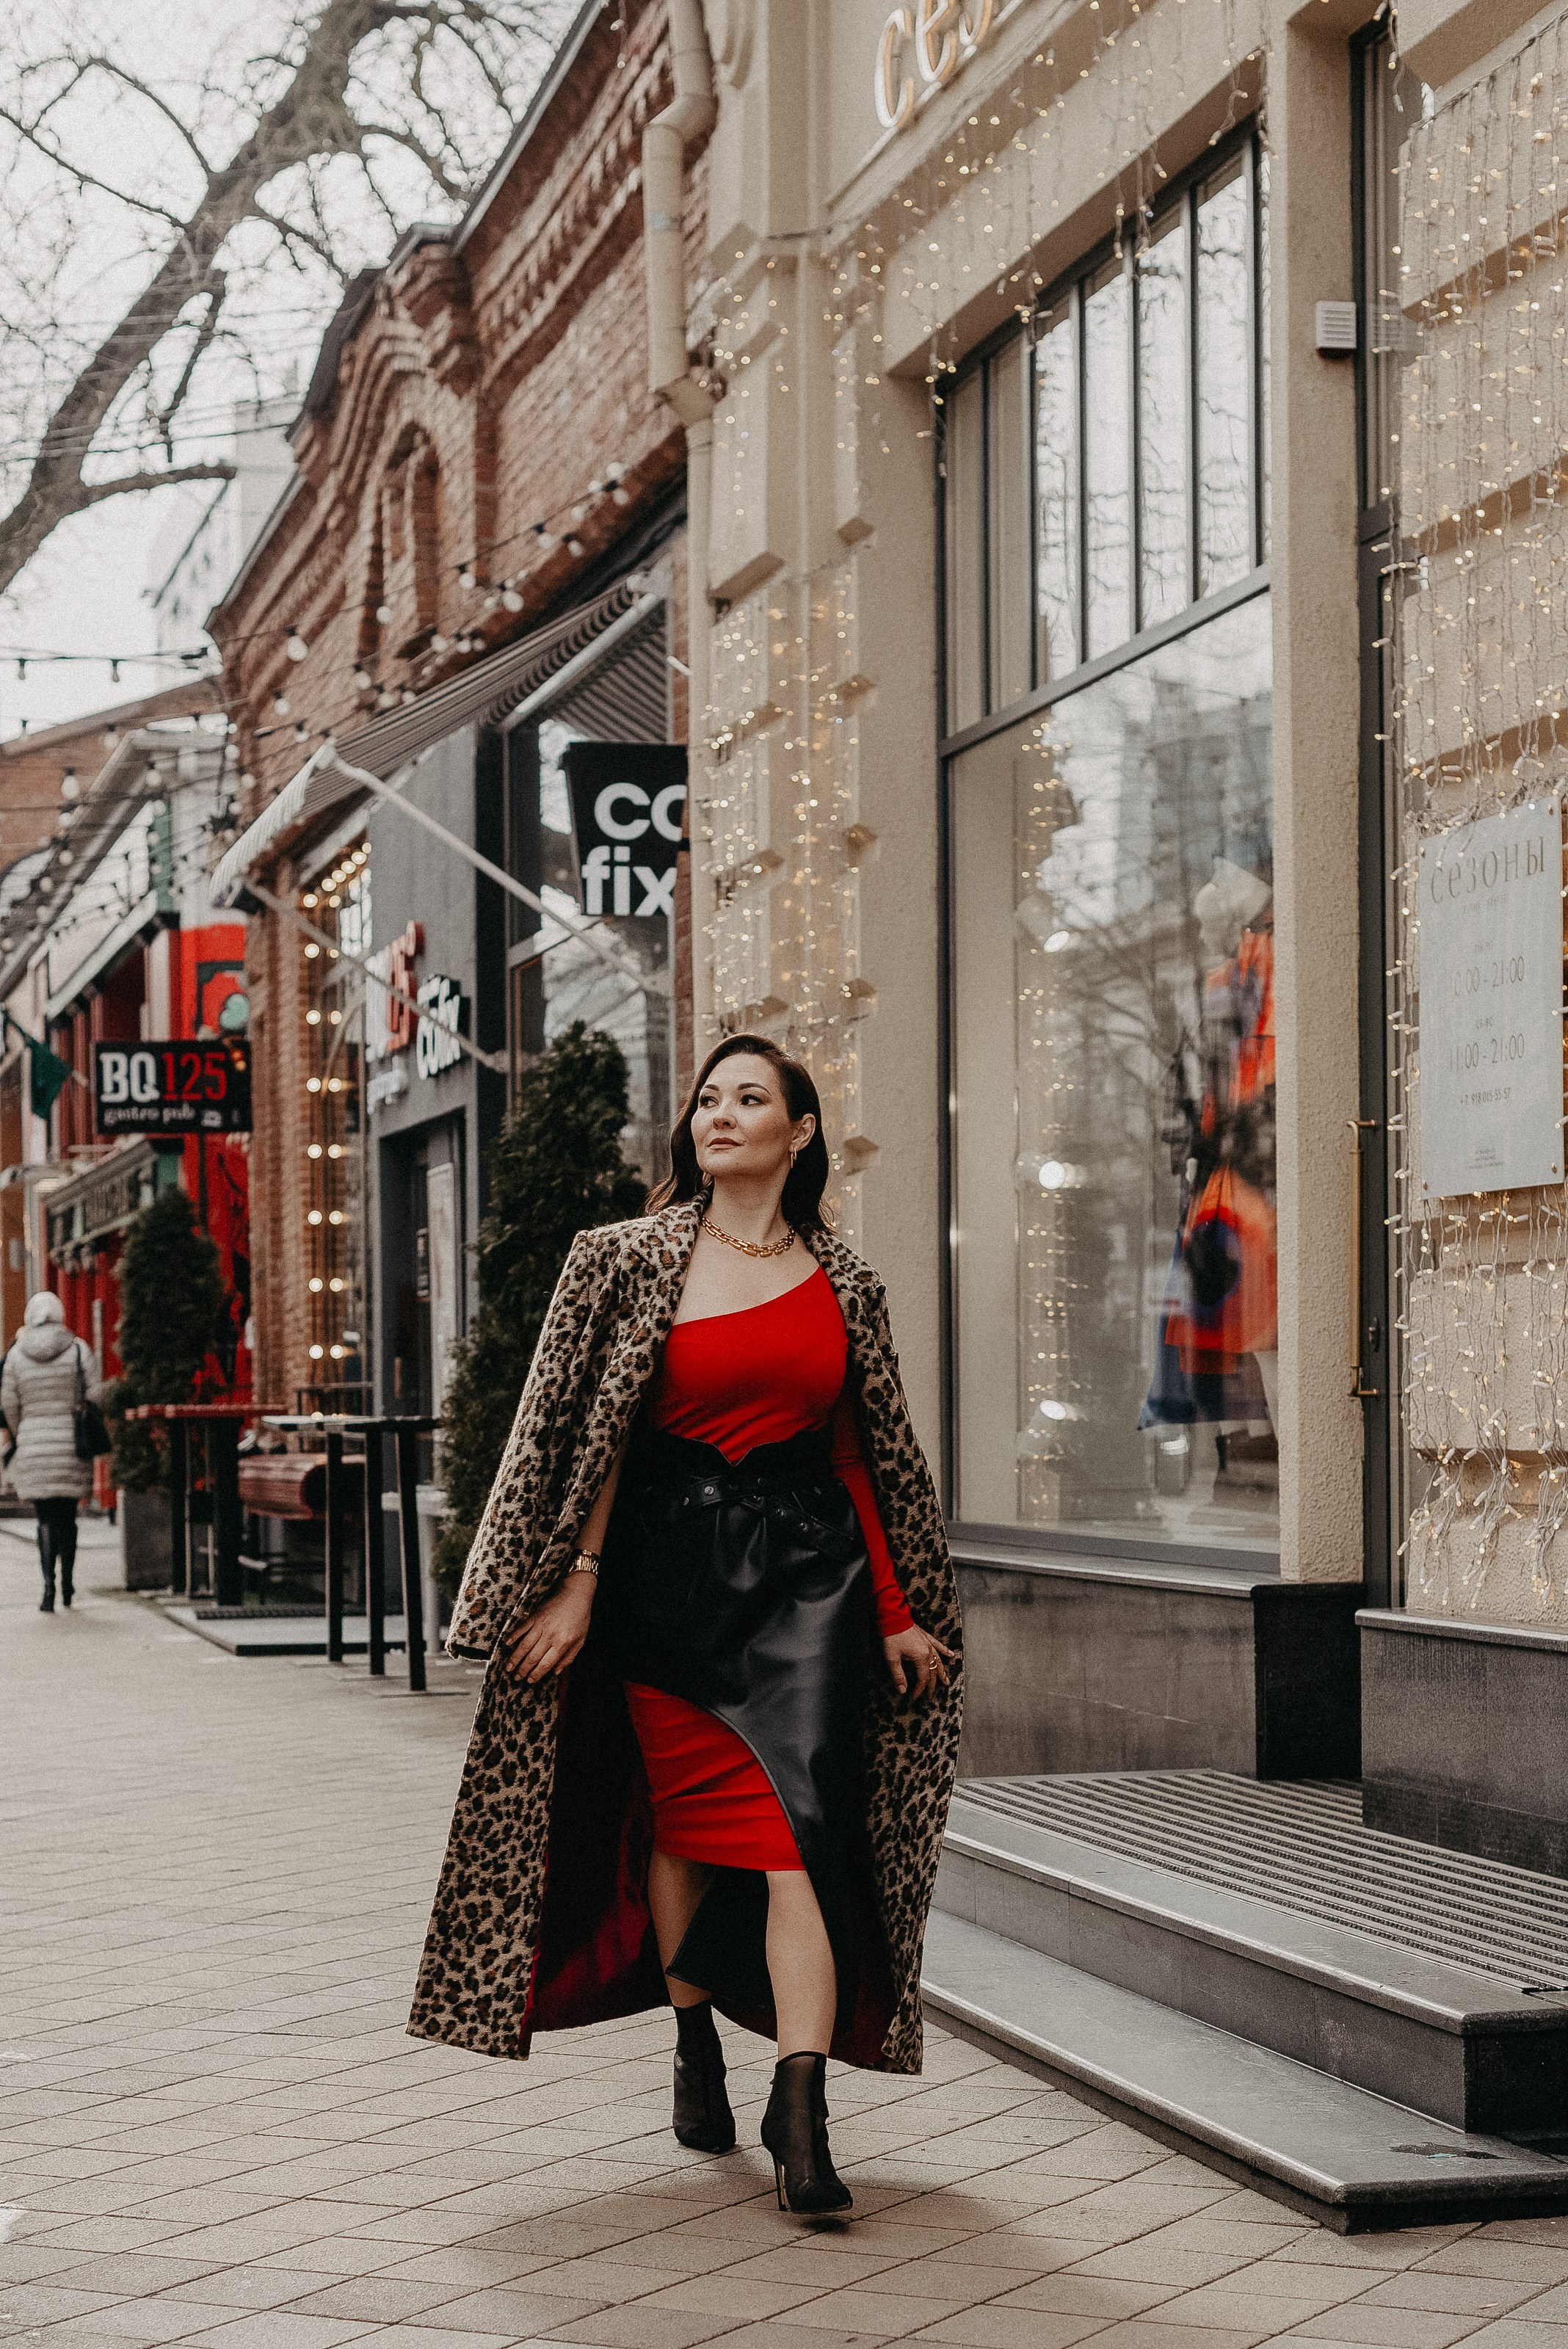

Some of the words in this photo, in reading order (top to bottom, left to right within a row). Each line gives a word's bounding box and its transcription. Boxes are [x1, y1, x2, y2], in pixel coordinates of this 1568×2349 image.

[594, 782, 688, 842] co
[581, 845, 678, 916] fix
[1491, 1032, 1525, 1064] 21:00
[99, 1051, 160, 1103] BQ
[162, 1052, 228, 1100] 125
[163, 1101, 195, 1124] pub
